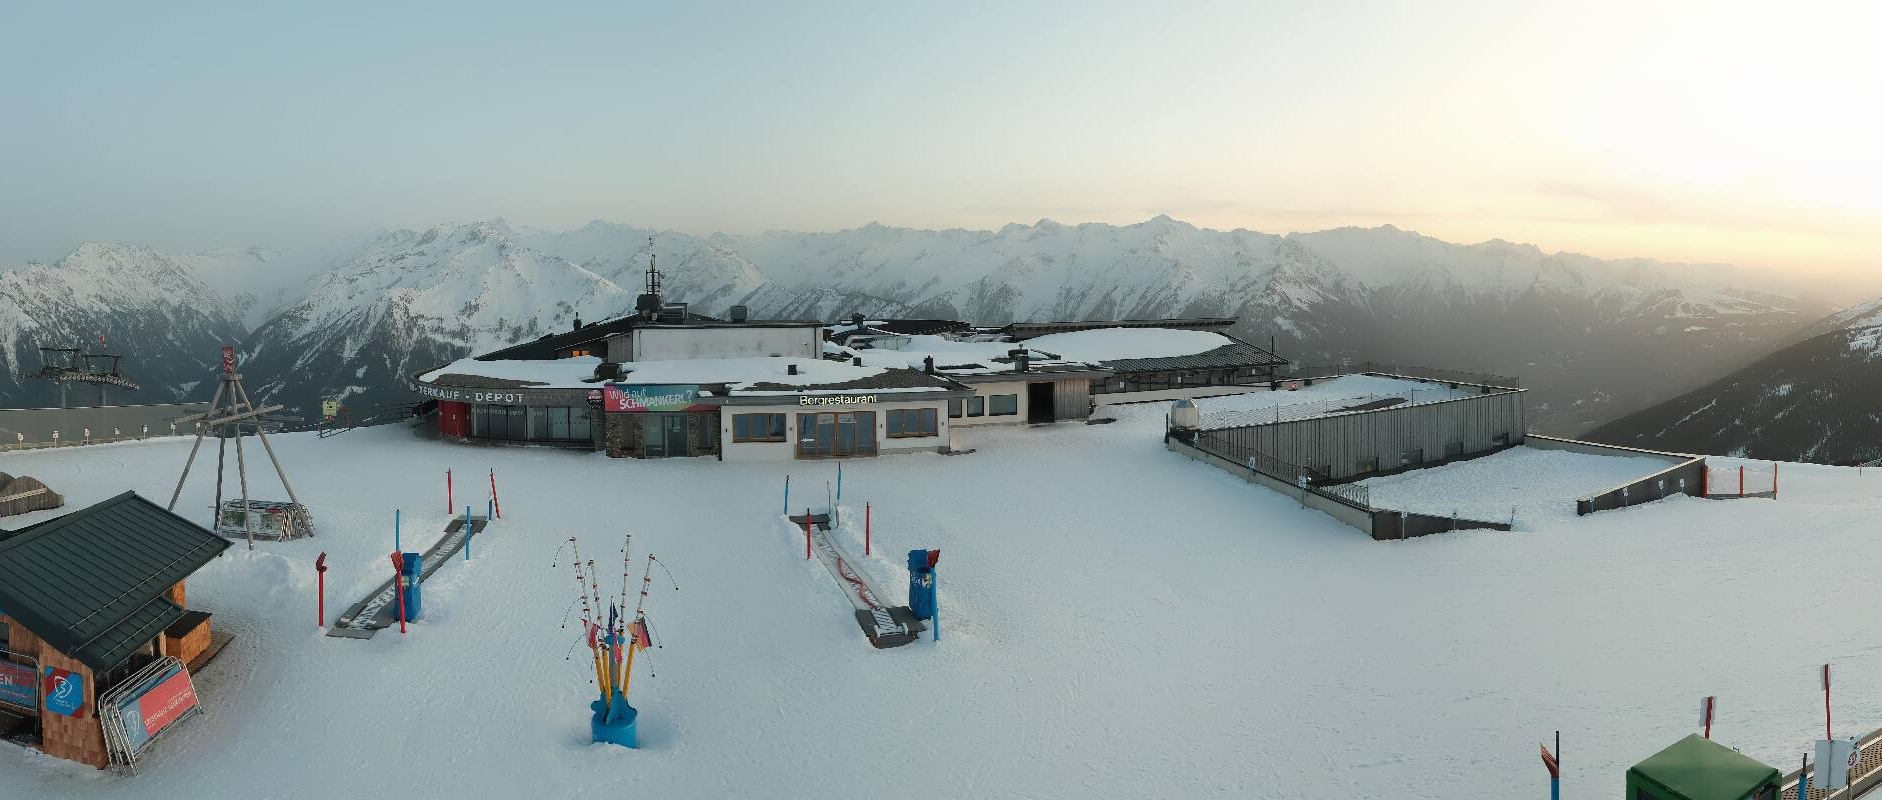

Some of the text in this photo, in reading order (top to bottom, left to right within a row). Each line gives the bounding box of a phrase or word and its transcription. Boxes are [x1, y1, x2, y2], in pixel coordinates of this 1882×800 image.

[475, 392, 524, 402] DEPOT
[609, 388, 630, 399] Wild
[631, 387, 647, 397] auf
[799, 394, 878, 407] Bergrestaurant
